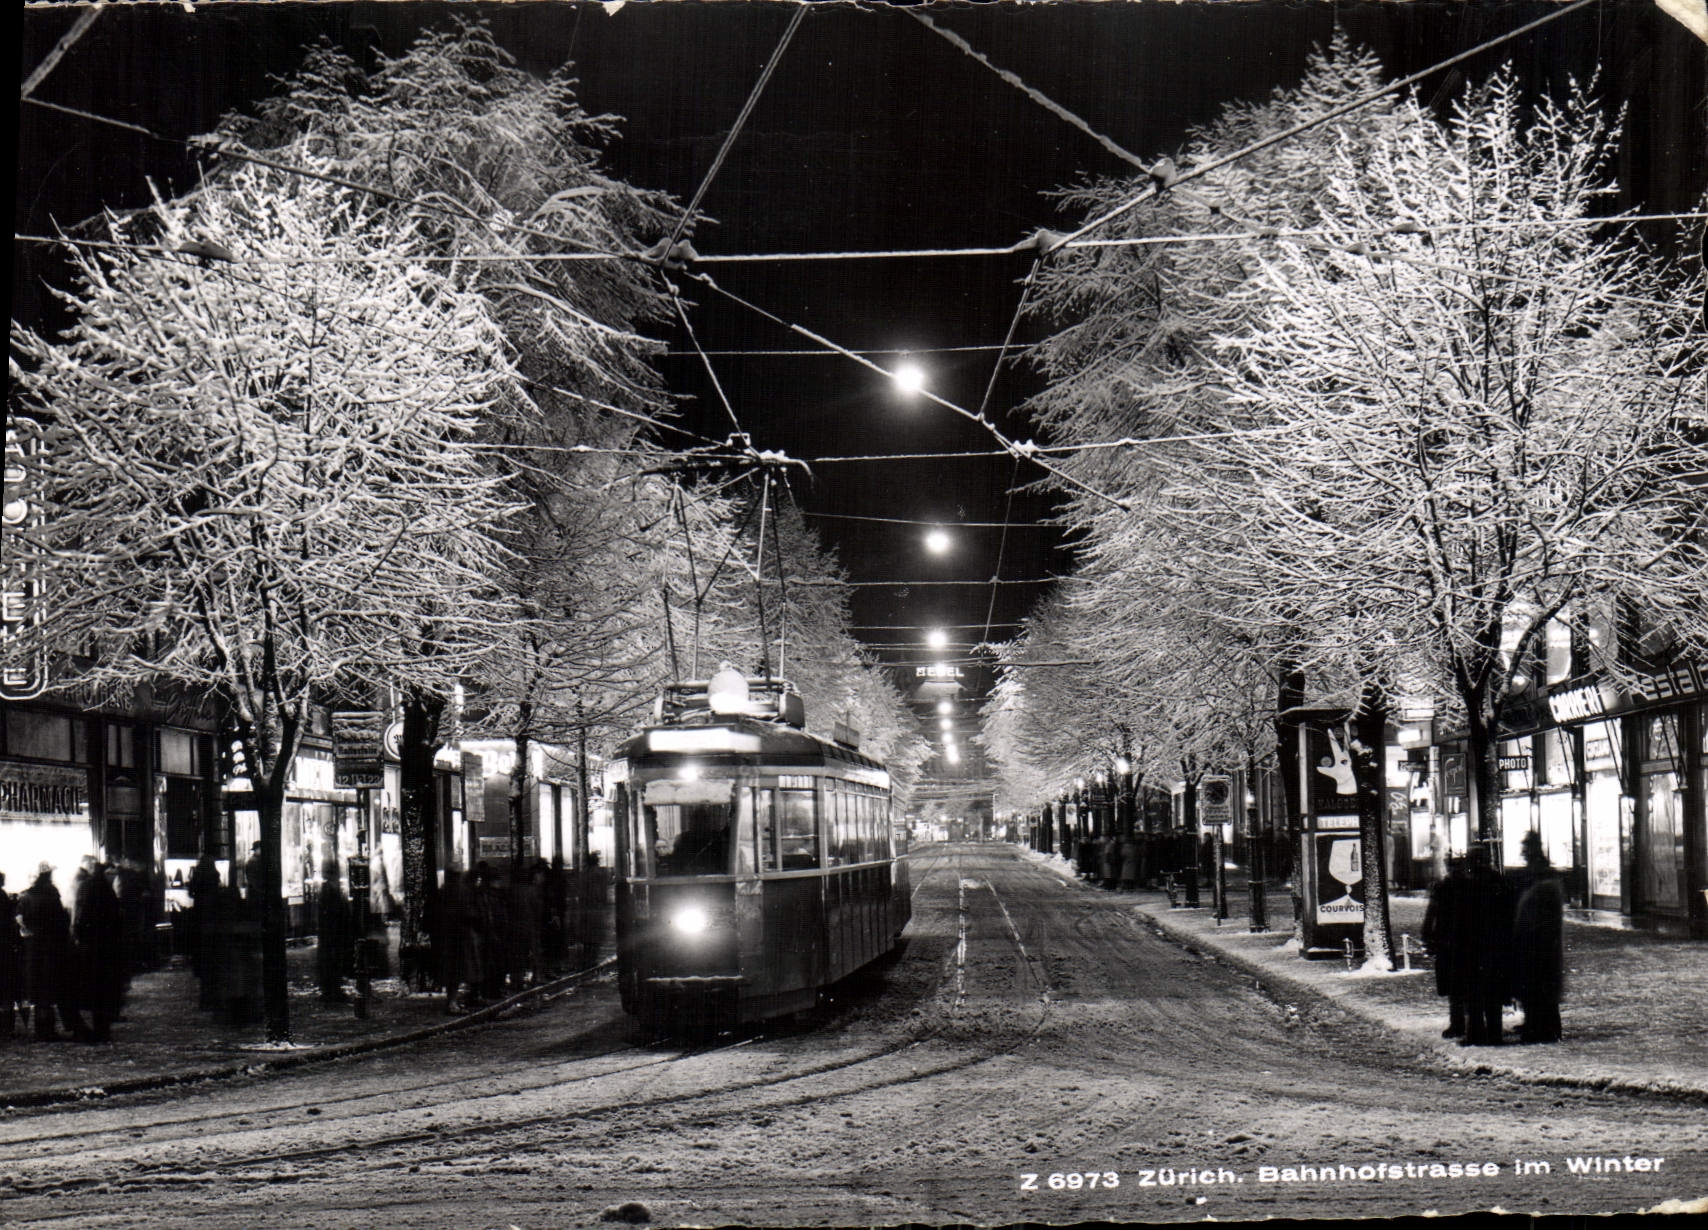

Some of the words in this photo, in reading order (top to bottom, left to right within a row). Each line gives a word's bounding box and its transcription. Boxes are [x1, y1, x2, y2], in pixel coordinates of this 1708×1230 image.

[1498, 757, 1526, 769] PHOTO
[0, 781, 84, 815] PHARMACIE
[1320, 904, 1365, 913] COURVOIS
